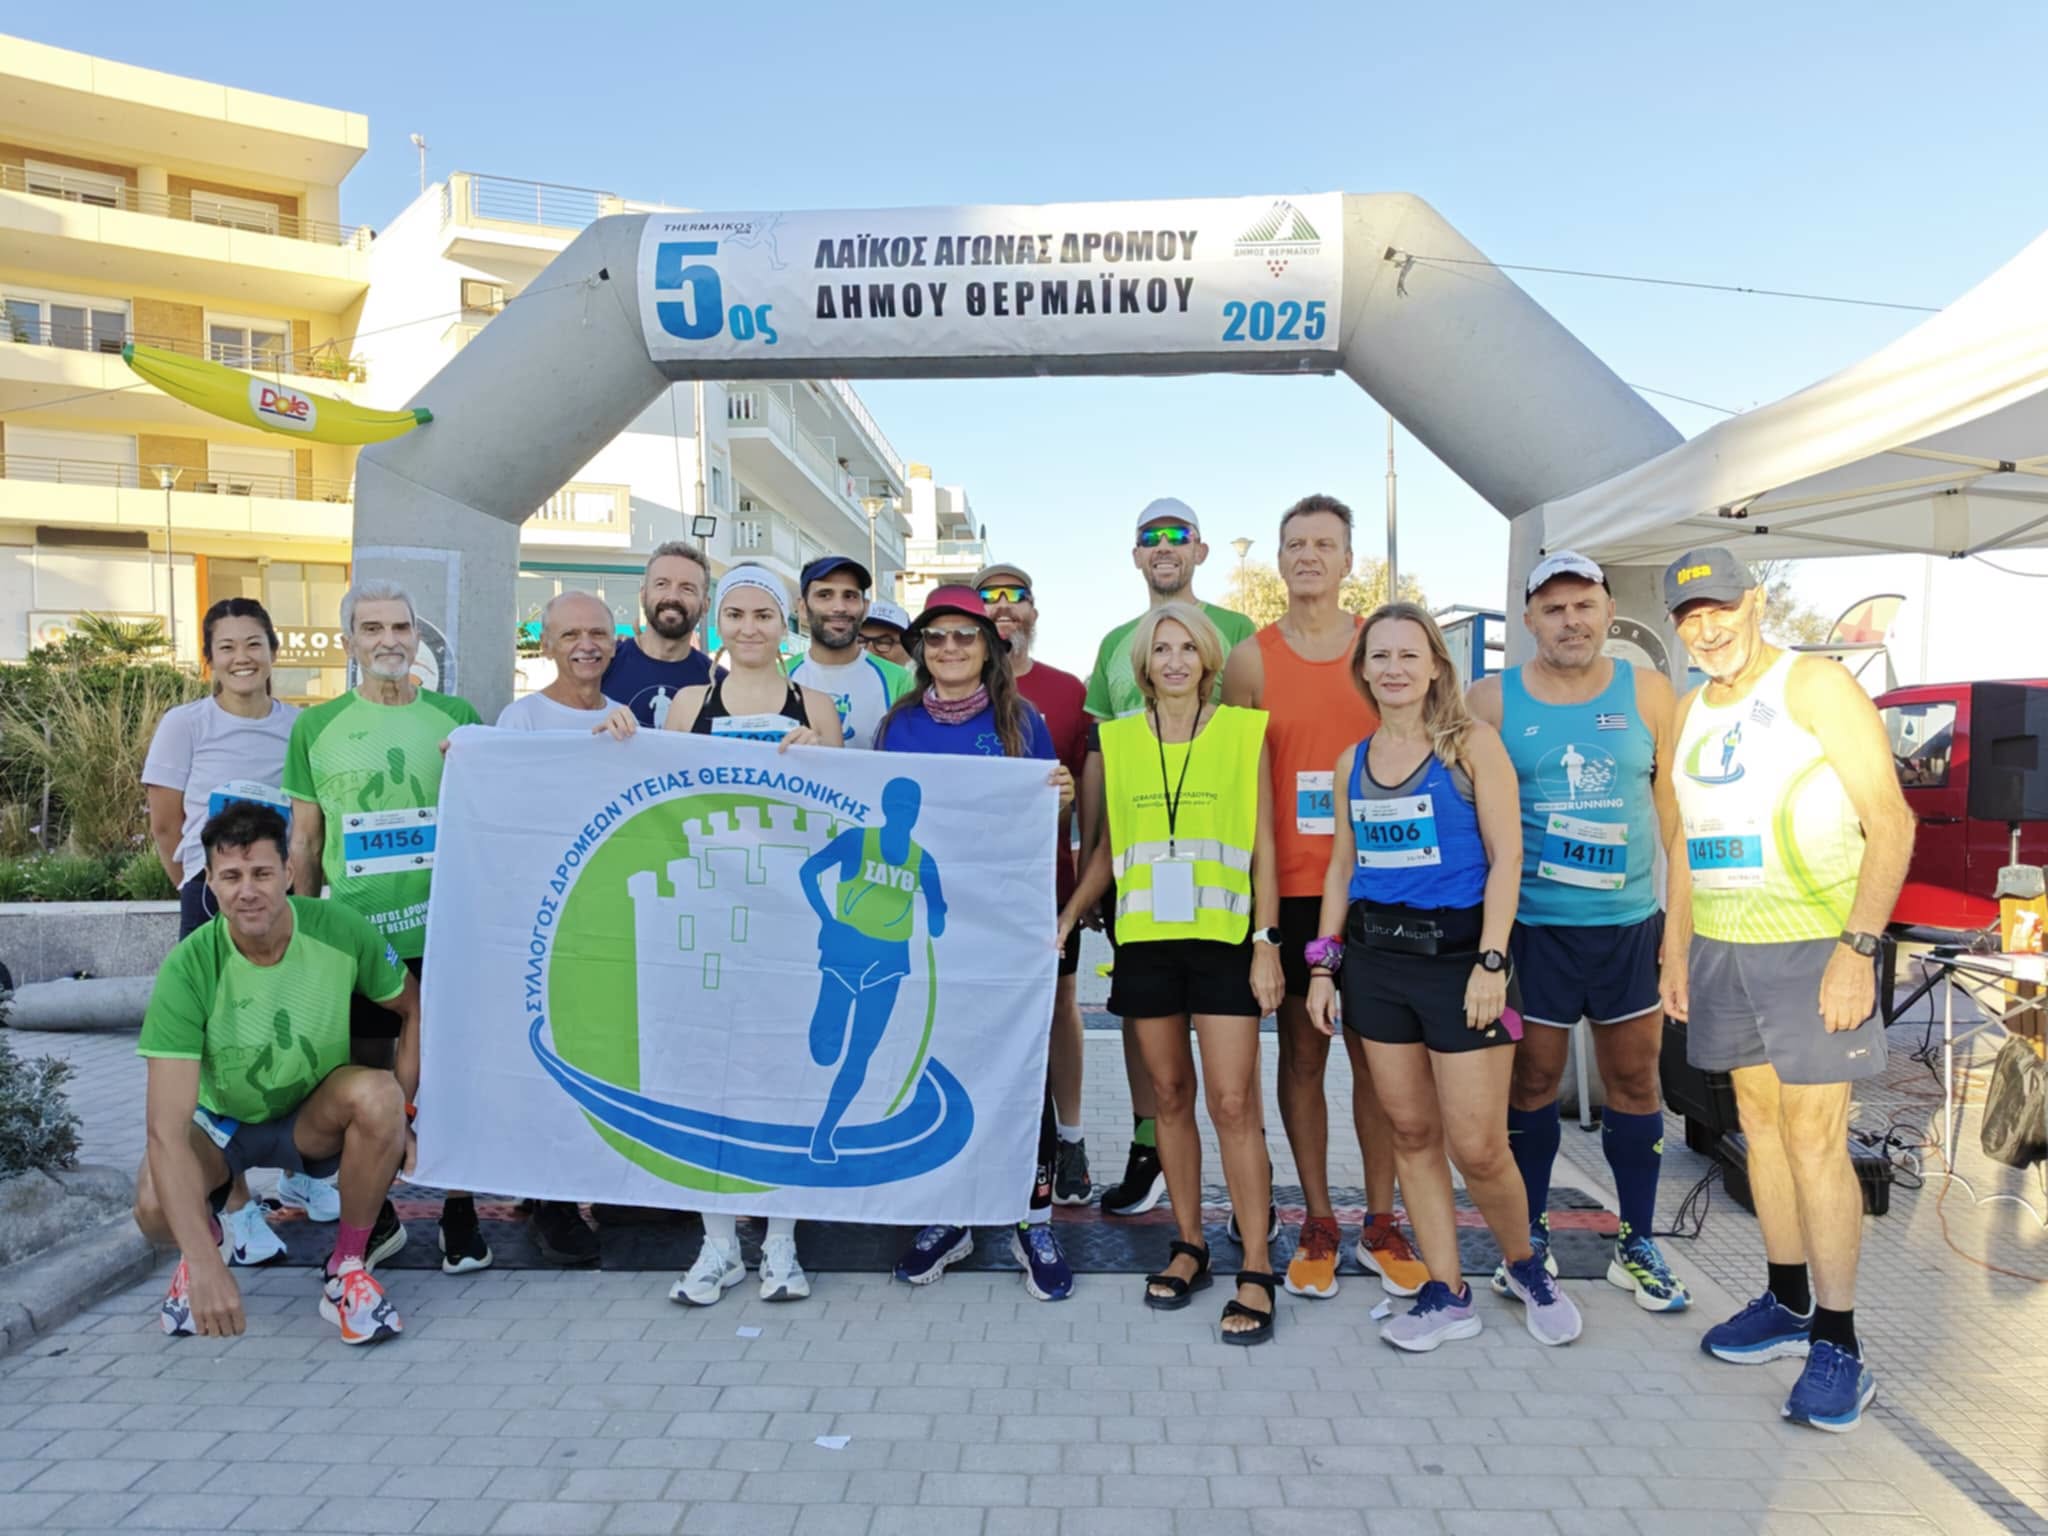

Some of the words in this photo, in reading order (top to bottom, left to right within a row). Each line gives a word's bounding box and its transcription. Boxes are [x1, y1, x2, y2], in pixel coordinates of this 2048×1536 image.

[663, 223, 752, 233] THERMAIKOS
[814, 233, 928, 268] ΛΑΪΚΟΣ
[934, 234, 1053, 266] ΑΓΩΝΑΣ
[1060, 230, 1198, 264] ΔΡΟΜΟΥ
[816, 282, 947, 319] ΔΗΜΟΥ
[966, 272, 1194, 317] ΘΕΡΜΑΪΚΟΥ
[1222, 300, 1326, 341] 2025
[260, 387, 309, 417] Dole
[1567, 798, 1624, 810] RUNNING
[359, 829, 424, 851] 14156
[1363, 822, 1421, 843] 14106
[1563, 841, 1614, 866] 14111
[1691, 838, 1744, 861] 14158
[525, 895, 558, 1012] ΣΥΛΛΟΓΟΣ
[550, 801, 623, 896] ΔΡΟΜΕΩΝ
[620, 770, 694, 806] ΥΓΕΙΑΣ
[698, 766, 870, 822] ΘΕΣΣΑΛΟΝΙΚΗΣ
